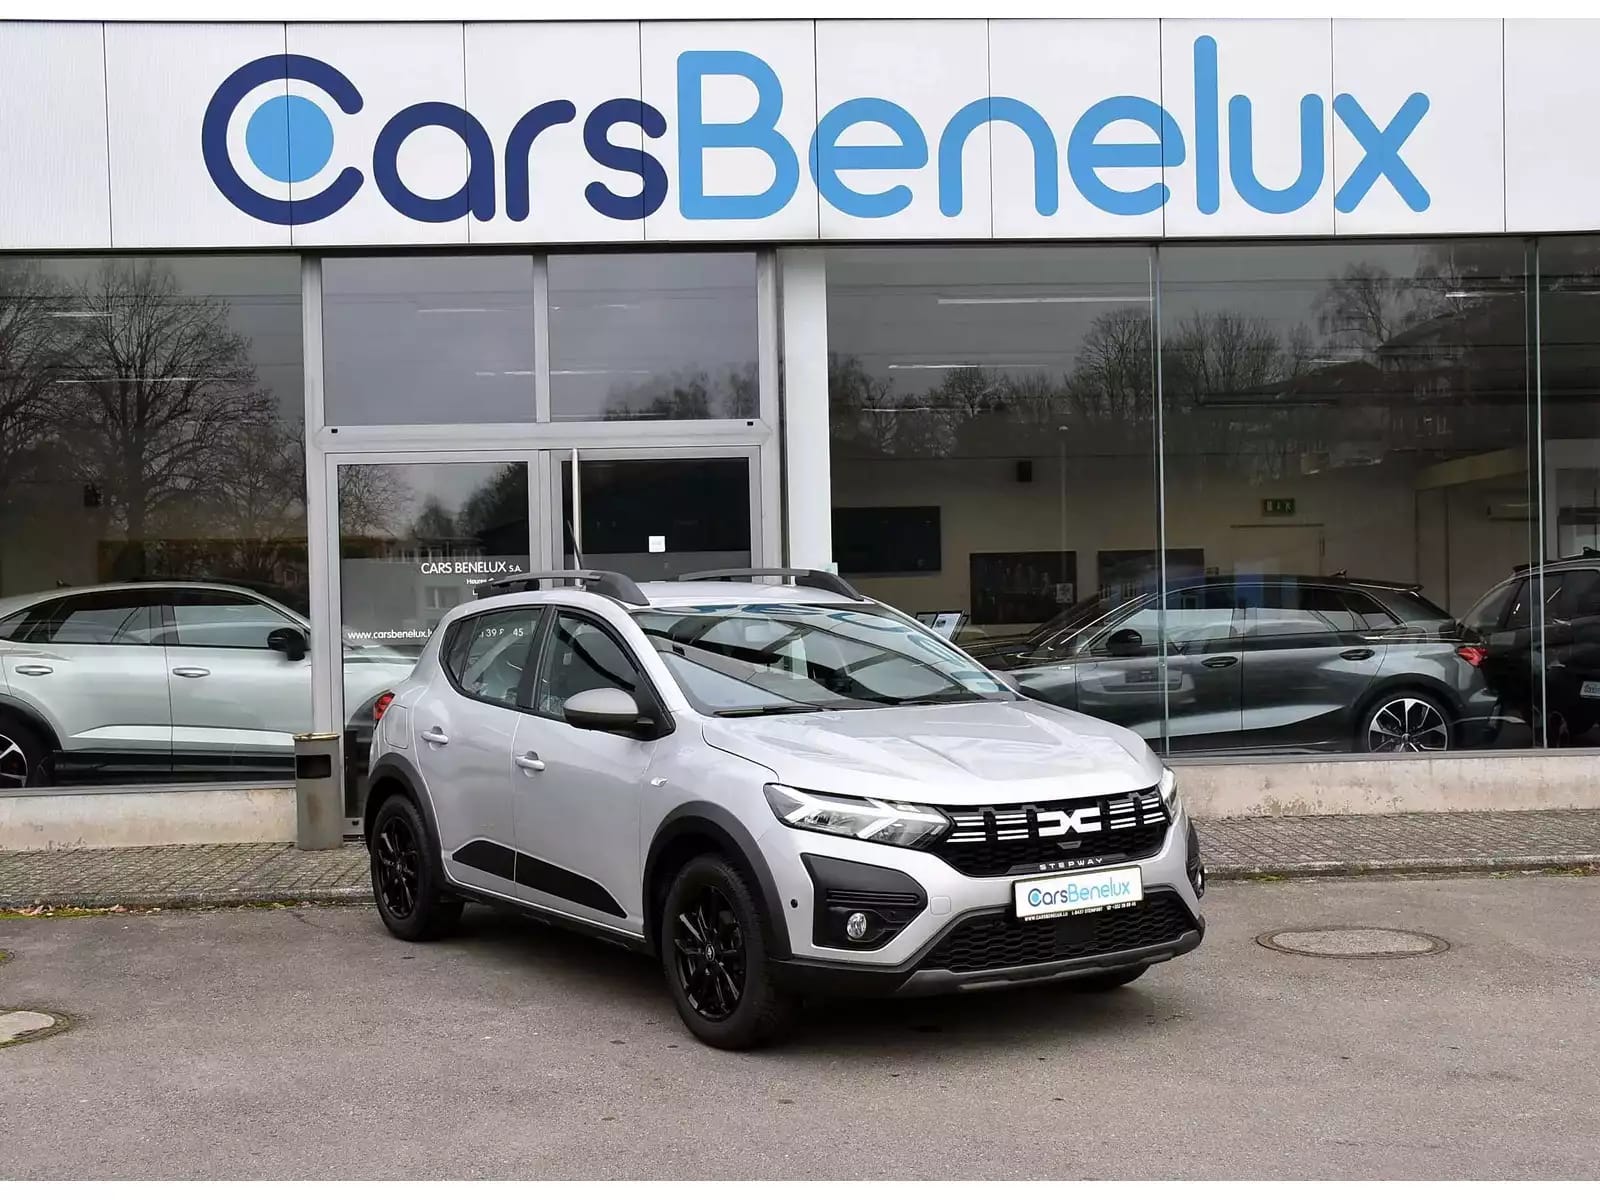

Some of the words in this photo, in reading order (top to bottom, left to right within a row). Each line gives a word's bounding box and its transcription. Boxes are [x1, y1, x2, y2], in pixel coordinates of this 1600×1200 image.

[202, 35, 1431, 226] CarsBenelux
[421, 562, 452, 574] CARS
[455, 561, 507, 573] BENELUX
[512, 627, 524, 637] 45
[1039, 857, 1103, 870] STEPWAY
[1027, 877, 1131, 907] CarsBenelux
